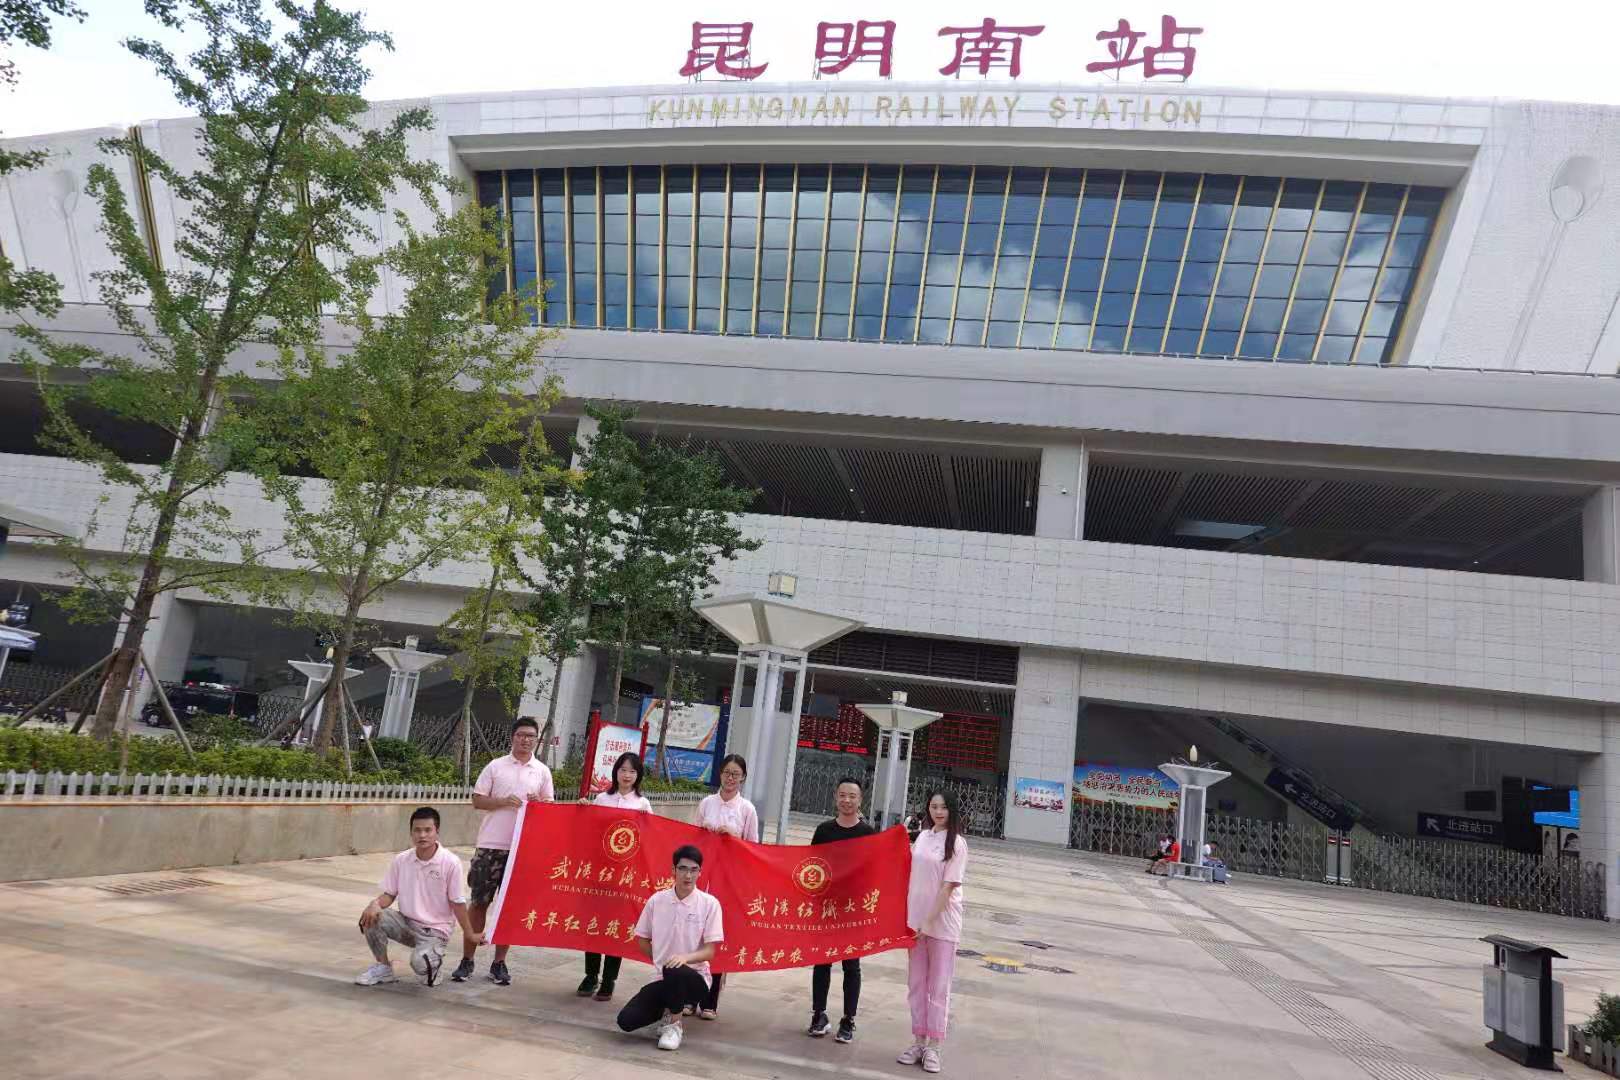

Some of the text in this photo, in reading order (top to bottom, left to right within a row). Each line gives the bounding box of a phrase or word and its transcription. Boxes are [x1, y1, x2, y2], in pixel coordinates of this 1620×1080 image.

[679, 15, 1204, 79] 昆明南站
[875, 95, 1021, 118] RAILWAY
[1050, 96, 1201, 123] STATION
[751, 917, 879, 932] WUHAN TEXTILE UNIVERSITY
